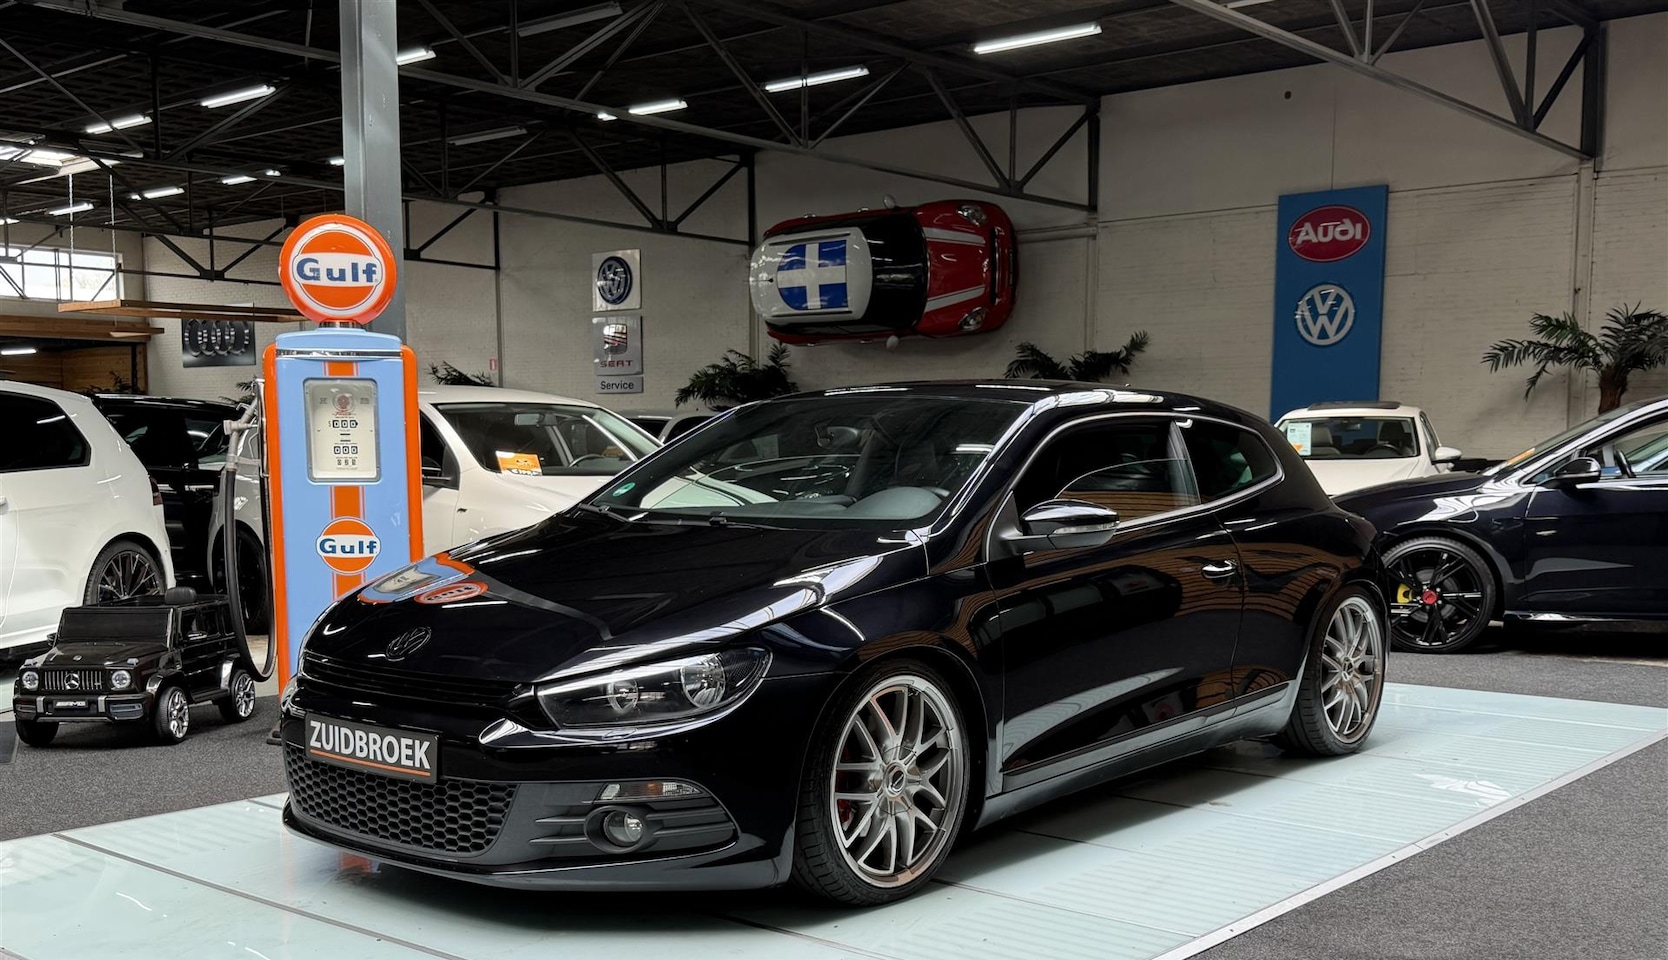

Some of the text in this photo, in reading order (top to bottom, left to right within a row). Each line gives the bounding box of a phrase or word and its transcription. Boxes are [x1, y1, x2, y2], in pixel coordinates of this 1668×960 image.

[296, 258, 377, 283] Gulf
[600, 360, 633, 368] SEAT
[600, 380, 635, 390] Service
[319, 538, 377, 554] Gulf
[309, 720, 431, 769] ZUIDBROEK
